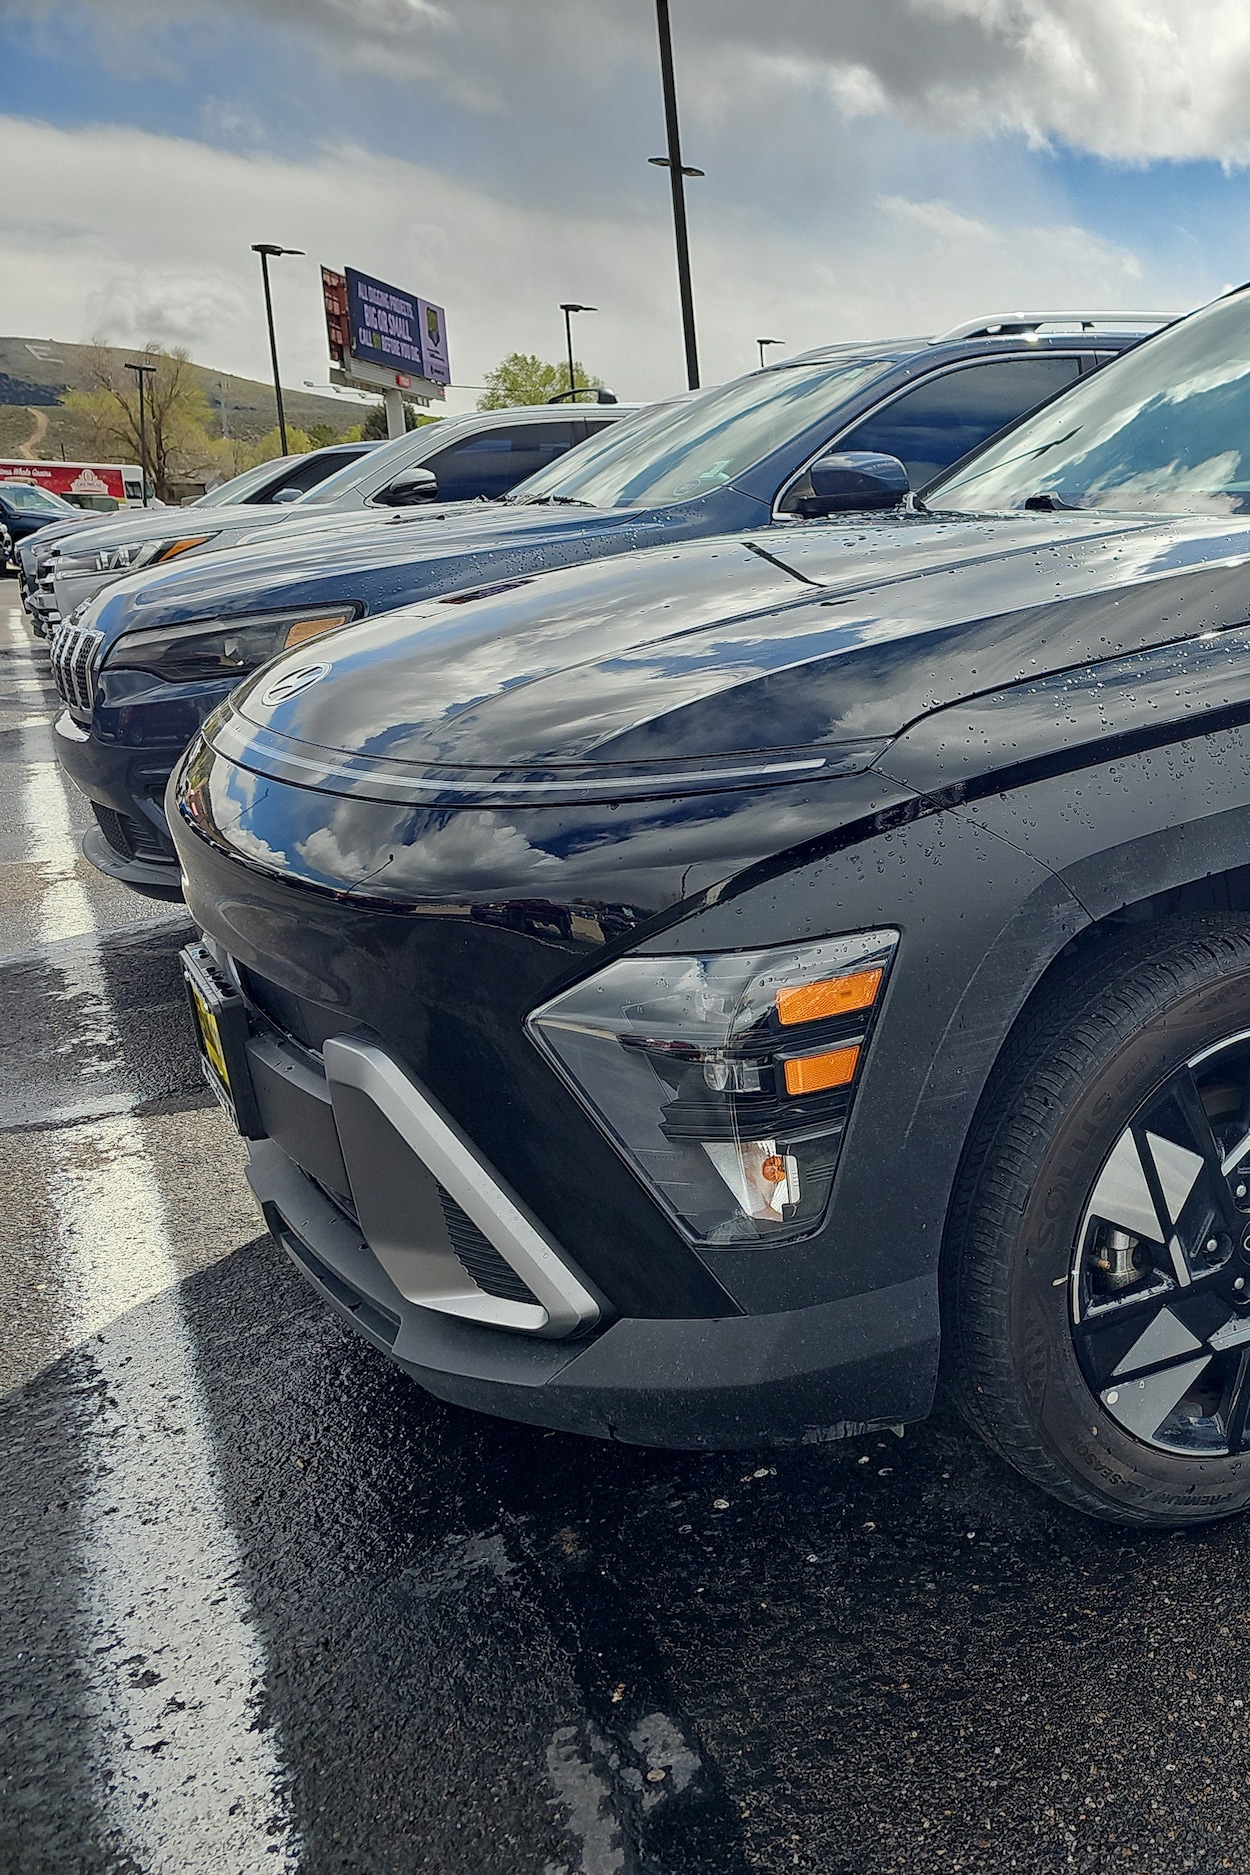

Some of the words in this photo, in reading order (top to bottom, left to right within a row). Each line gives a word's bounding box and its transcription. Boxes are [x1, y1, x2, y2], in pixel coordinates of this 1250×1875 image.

[358, 281, 369, 301] ALL
[363, 303, 378, 331] BIG
[377, 309, 389, 333] OR
[358, 326, 373, 348] CALL
[381, 334, 401, 356] BEFORE
[13, 467, 31, 477] Whole
[1037, 1091, 1115, 1250] SOLUS
[1066, 1432, 1154, 1498] ALL-SEASON
[1153, 1490, 1232, 1507] PREMIUM
